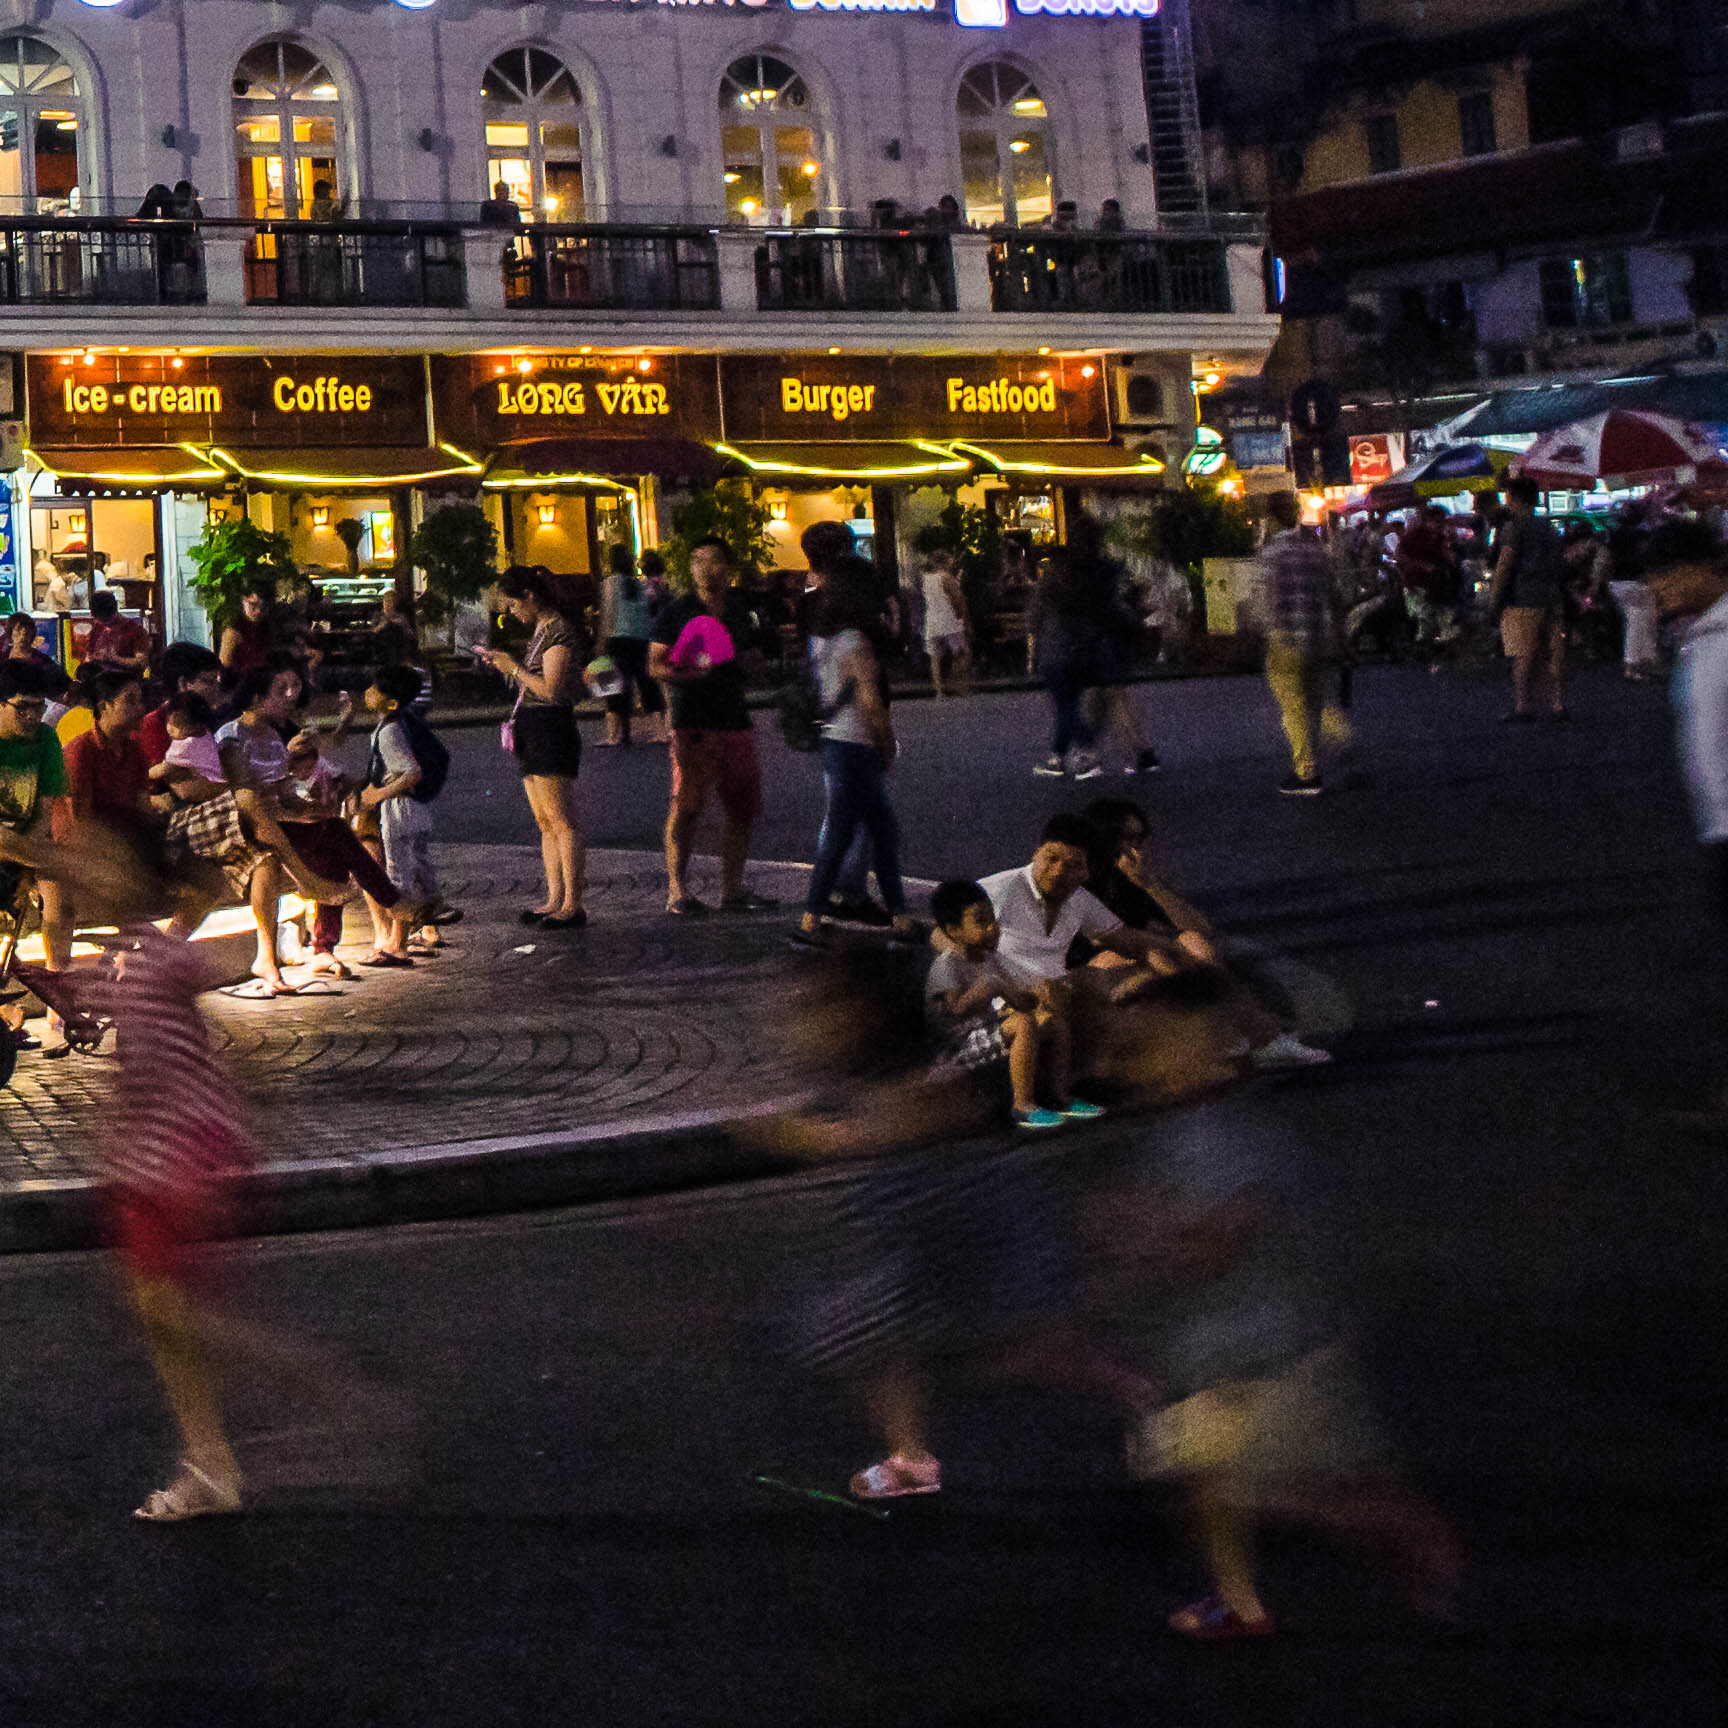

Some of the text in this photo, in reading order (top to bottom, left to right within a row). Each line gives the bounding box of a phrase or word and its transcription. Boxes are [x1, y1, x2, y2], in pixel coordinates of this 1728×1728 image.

[273, 377, 372, 413] Coffee
[497, 375, 671, 415] LONG VÂN
[781, 377, 876, 422] Burger
[947, 377, 1056, 414] Fastfood
